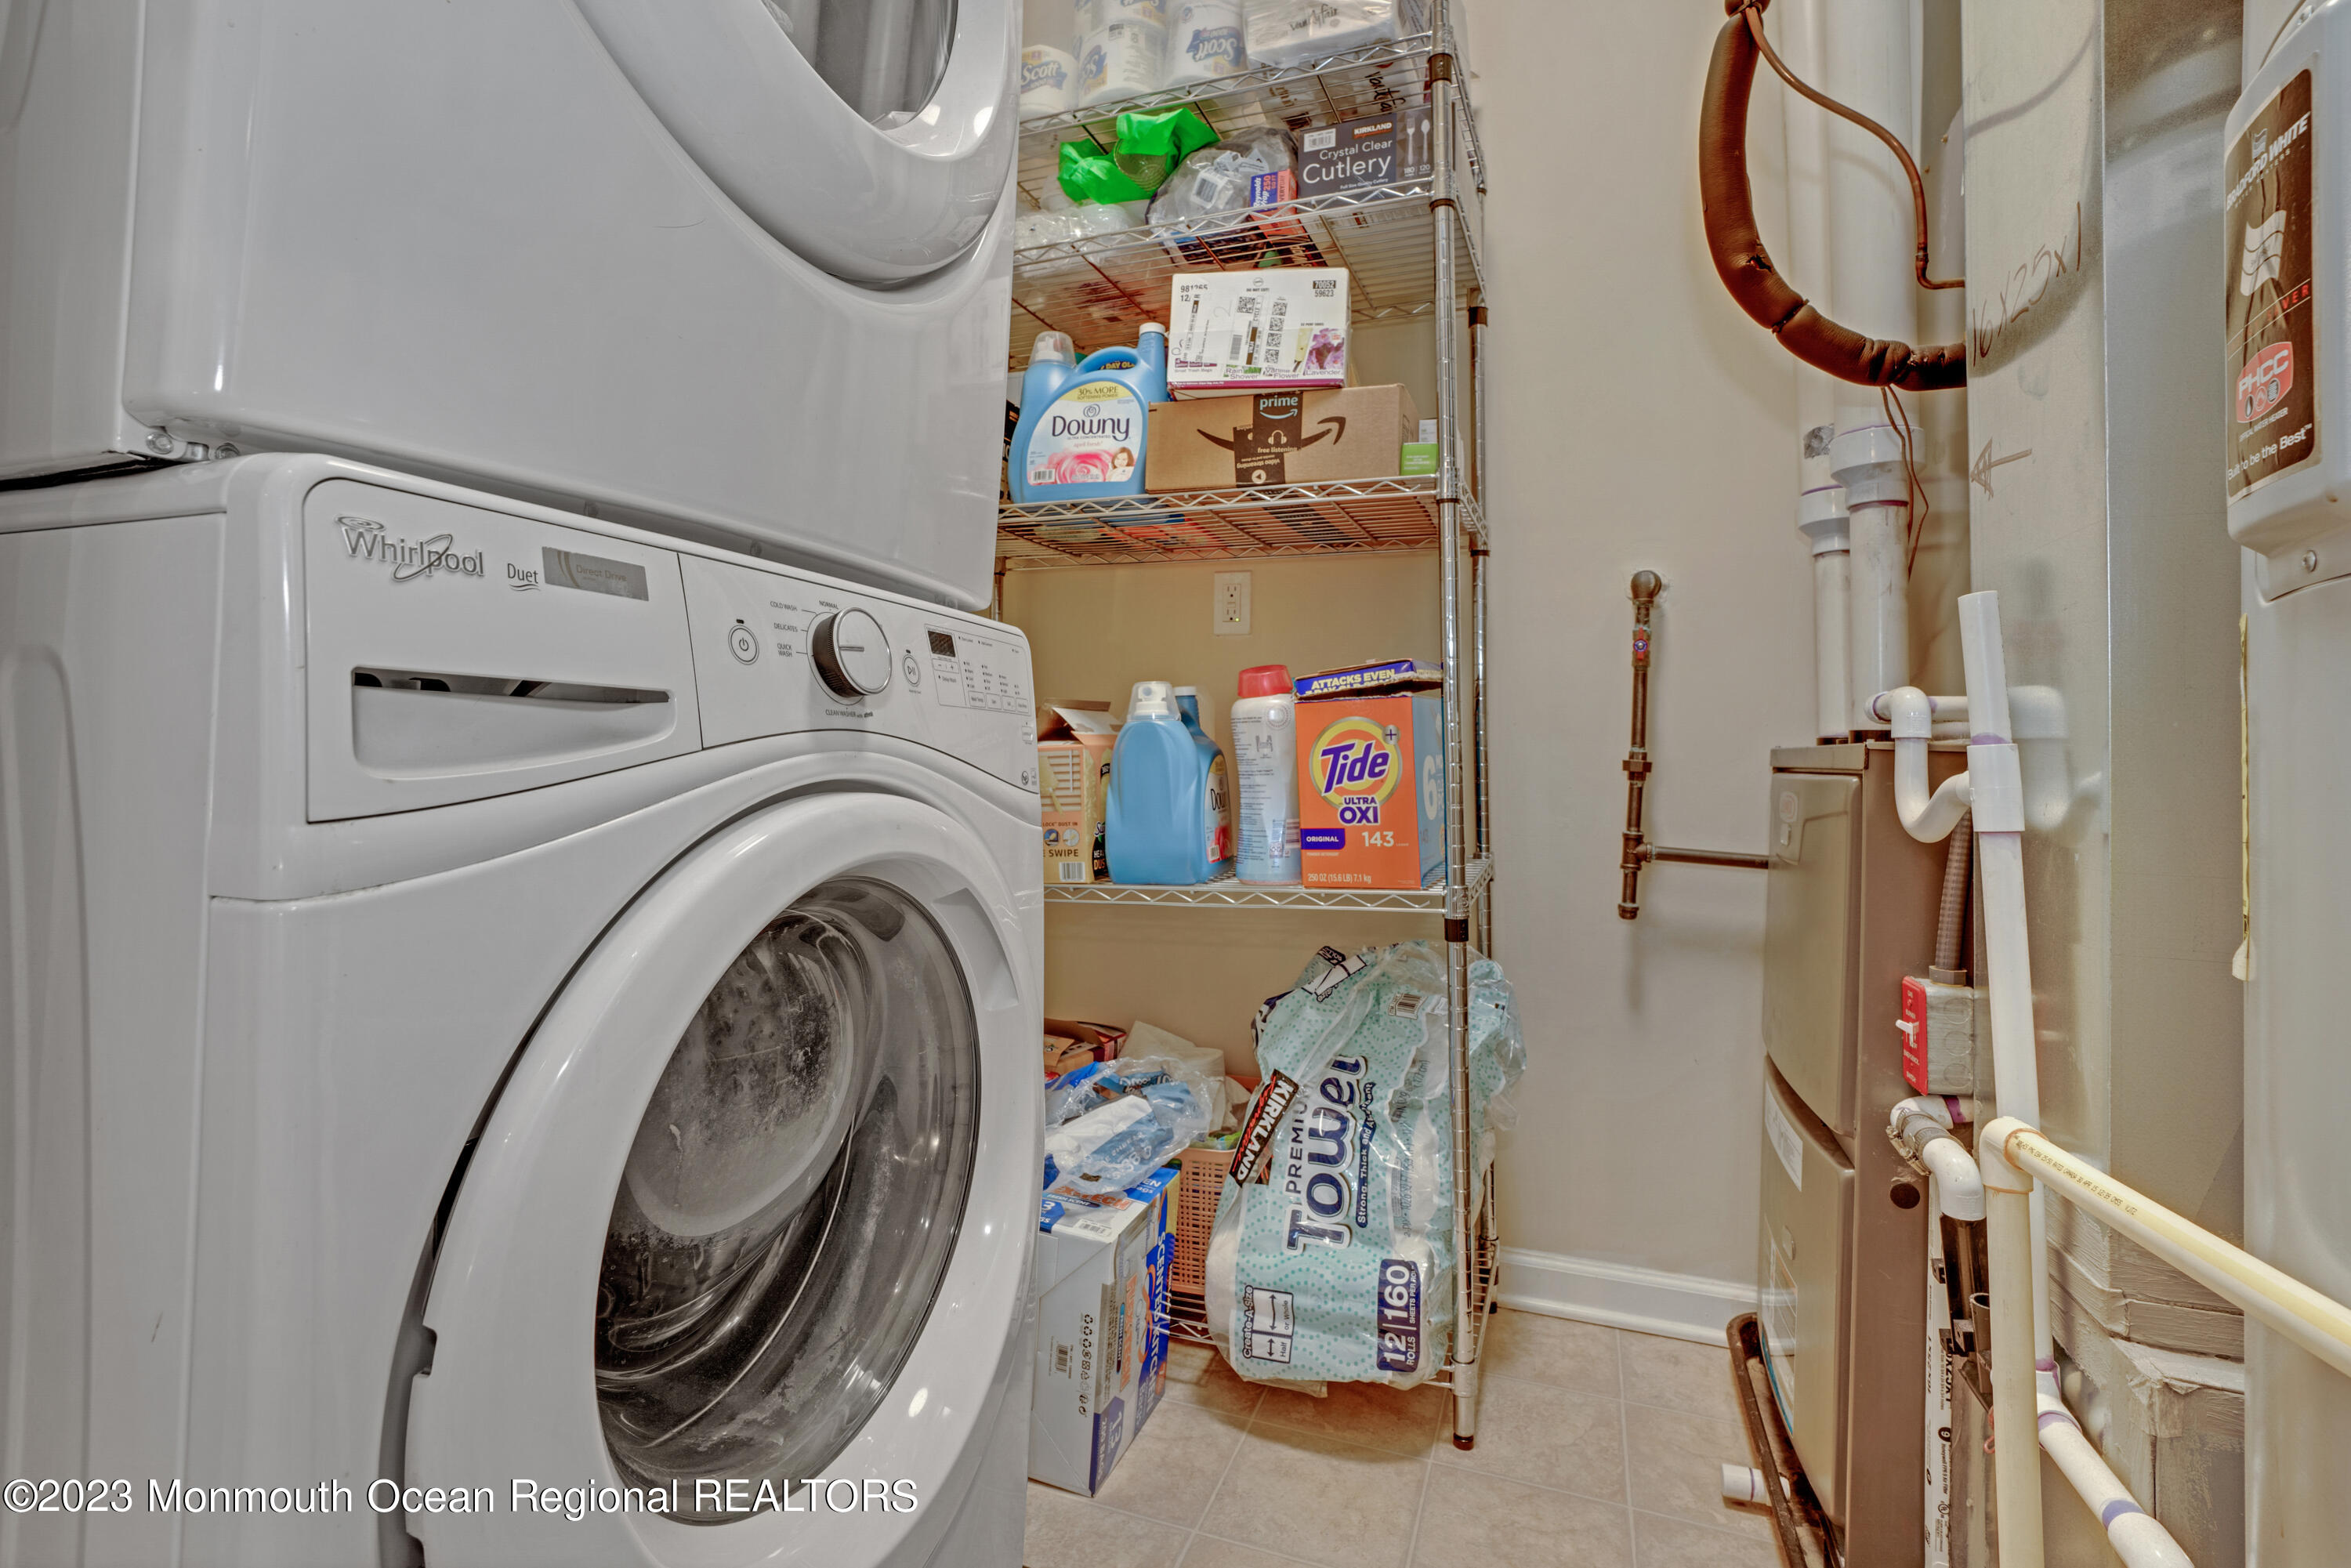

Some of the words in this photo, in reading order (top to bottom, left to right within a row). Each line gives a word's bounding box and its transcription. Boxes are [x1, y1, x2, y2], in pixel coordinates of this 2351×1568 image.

[1194, 37, 1237, 60] Scott
[1021, 63, 1059, 85] Scott
[1354, 122, 1392, 135] KIRKLAND
[2269, 110, 2311, 161] WHITE
[1320, 144, 1359, 161] Crystal
[1362, 139, 1393, 152] Clear
[1302, 156, 1392, 184] Cutlery
[2239, 349, 2288, 400] PHCC
[1260, 395, 1299, 410] prime
[1052, 415, 1131, 442] Downy
[2249, 440, 2260, 465] be
[2261, 431, 2278, 457] the
[340, 527, 484, 578] Whirlpool
[507, 563, 539, 585] Duet
[577, 565, 603, 577] Direct
[605, 570, 627, 581] Drive
[819, 600, 839, 610] NORMAL
[774, 622, 798, 632] DELICATES
[1311, 673, 1361, 691] ATTACKS
[1364, 669, 1395, 682] EVEN
[1320, 739, 1390, 795] Tide
[1422, 755, 1437, 821] 6
[1339, 806, 1379, 824] OXI
[1362, 831, 1394, 847] 143
[1049, 849, 1078, 857] SWIPE
[1354, 874, 1363, 882] 7.1
[1364, 874, 1371, 884] kg
[1237, 1080, 1295, 1181] KIRKLAND
[1363, 1127, 1372, 1145] and
[1286, 1058, 1364, 1251] Towel
[1360, 1146, 1371, 1179] Thick
[1043, 1200, 1056, 1211] 3
[1153, 1231, 1166, 1323] SCENTED
[1385, 1266, 1411, 1320] 160
[1243, 1285, 1255, 1358] Create-A-Size
[1280, 1342, 1288, 1358] Half
[1383, 1332, 1407, 1362] 12
[1407, 1335, 1416, 1366] ROLLS
[1110, 1410, 1123, 1450] 13
